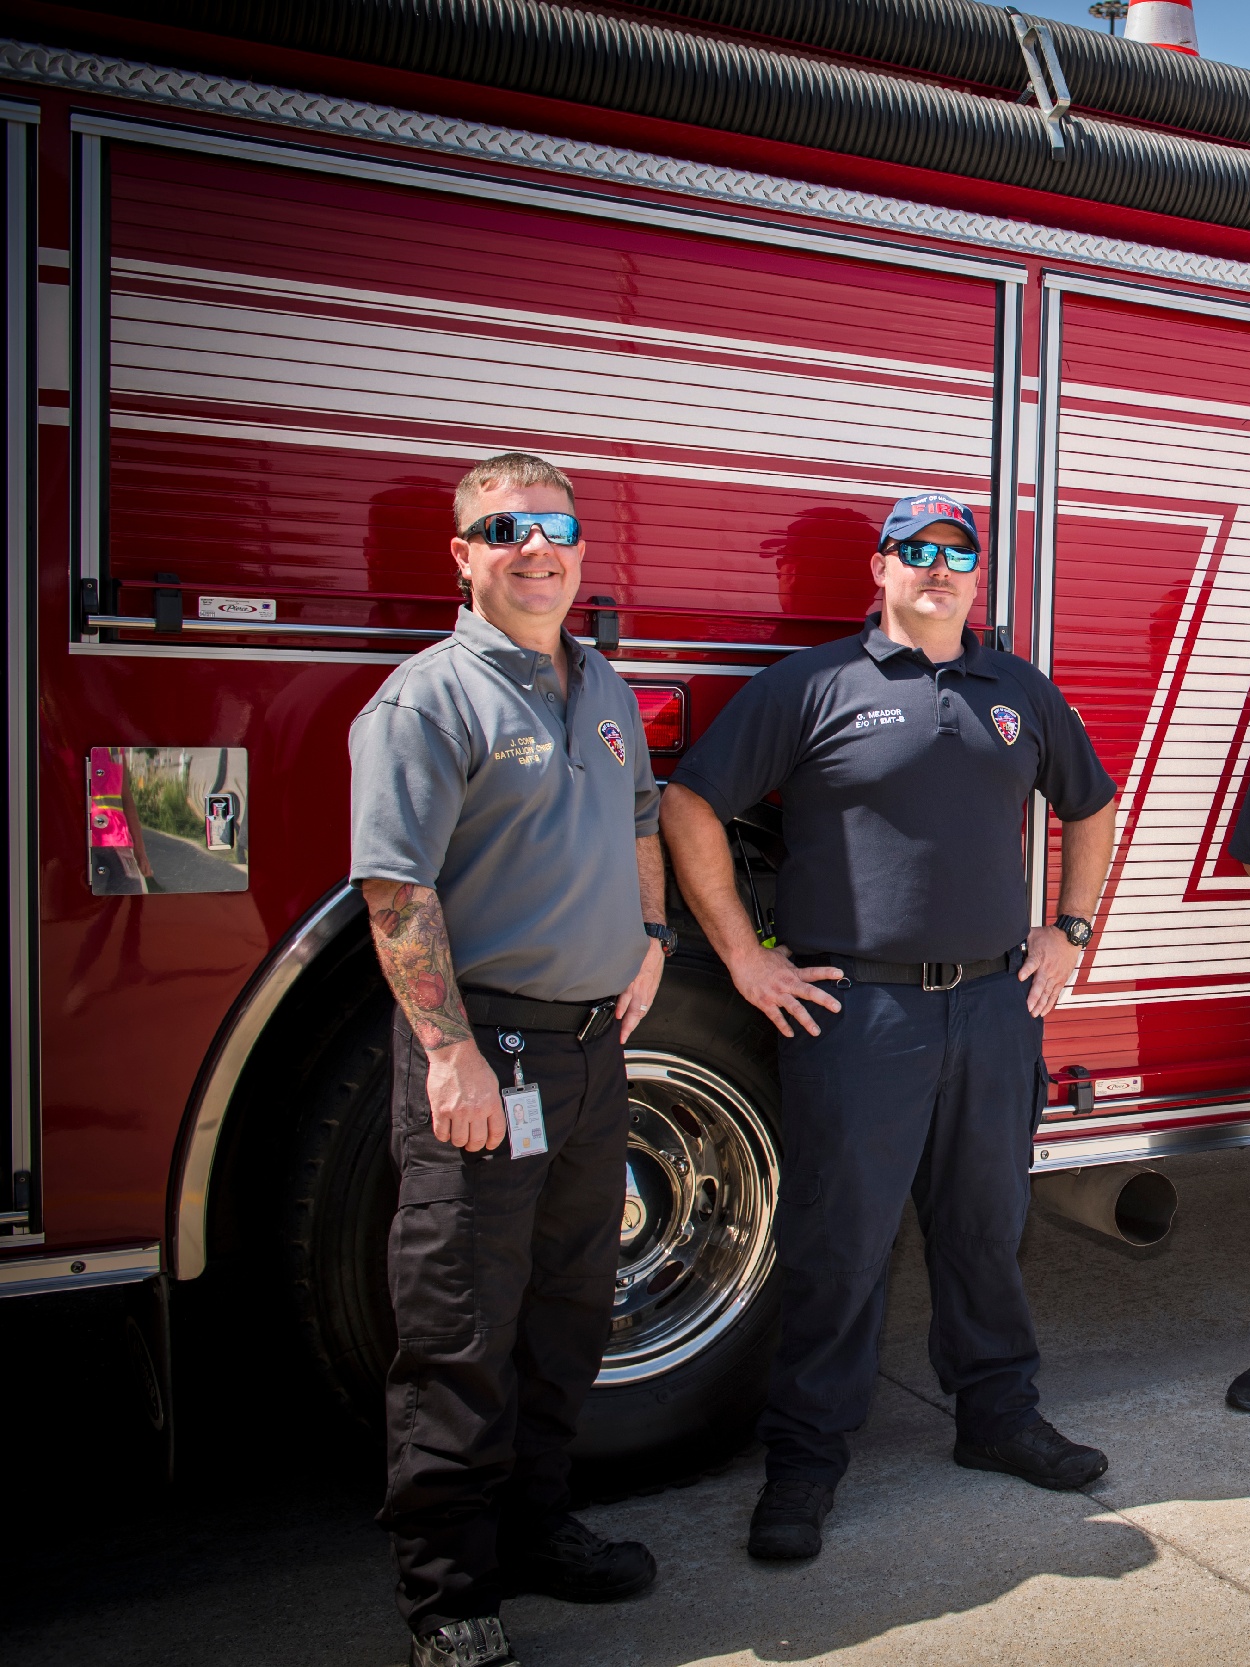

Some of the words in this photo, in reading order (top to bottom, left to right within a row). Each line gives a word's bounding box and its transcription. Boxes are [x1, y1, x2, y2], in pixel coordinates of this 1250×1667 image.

[911, 502, 966, 524] FIRE
[867, 708, 902, 719] MEADOR
[855, 720, 870, 728] E/O
[880, 715, 906, 725] EMT-B
[510, 739, 517, 747] J.
[494, 748, 534, 760] BATTALION
[535, 742, 553, 753] CHIEF
